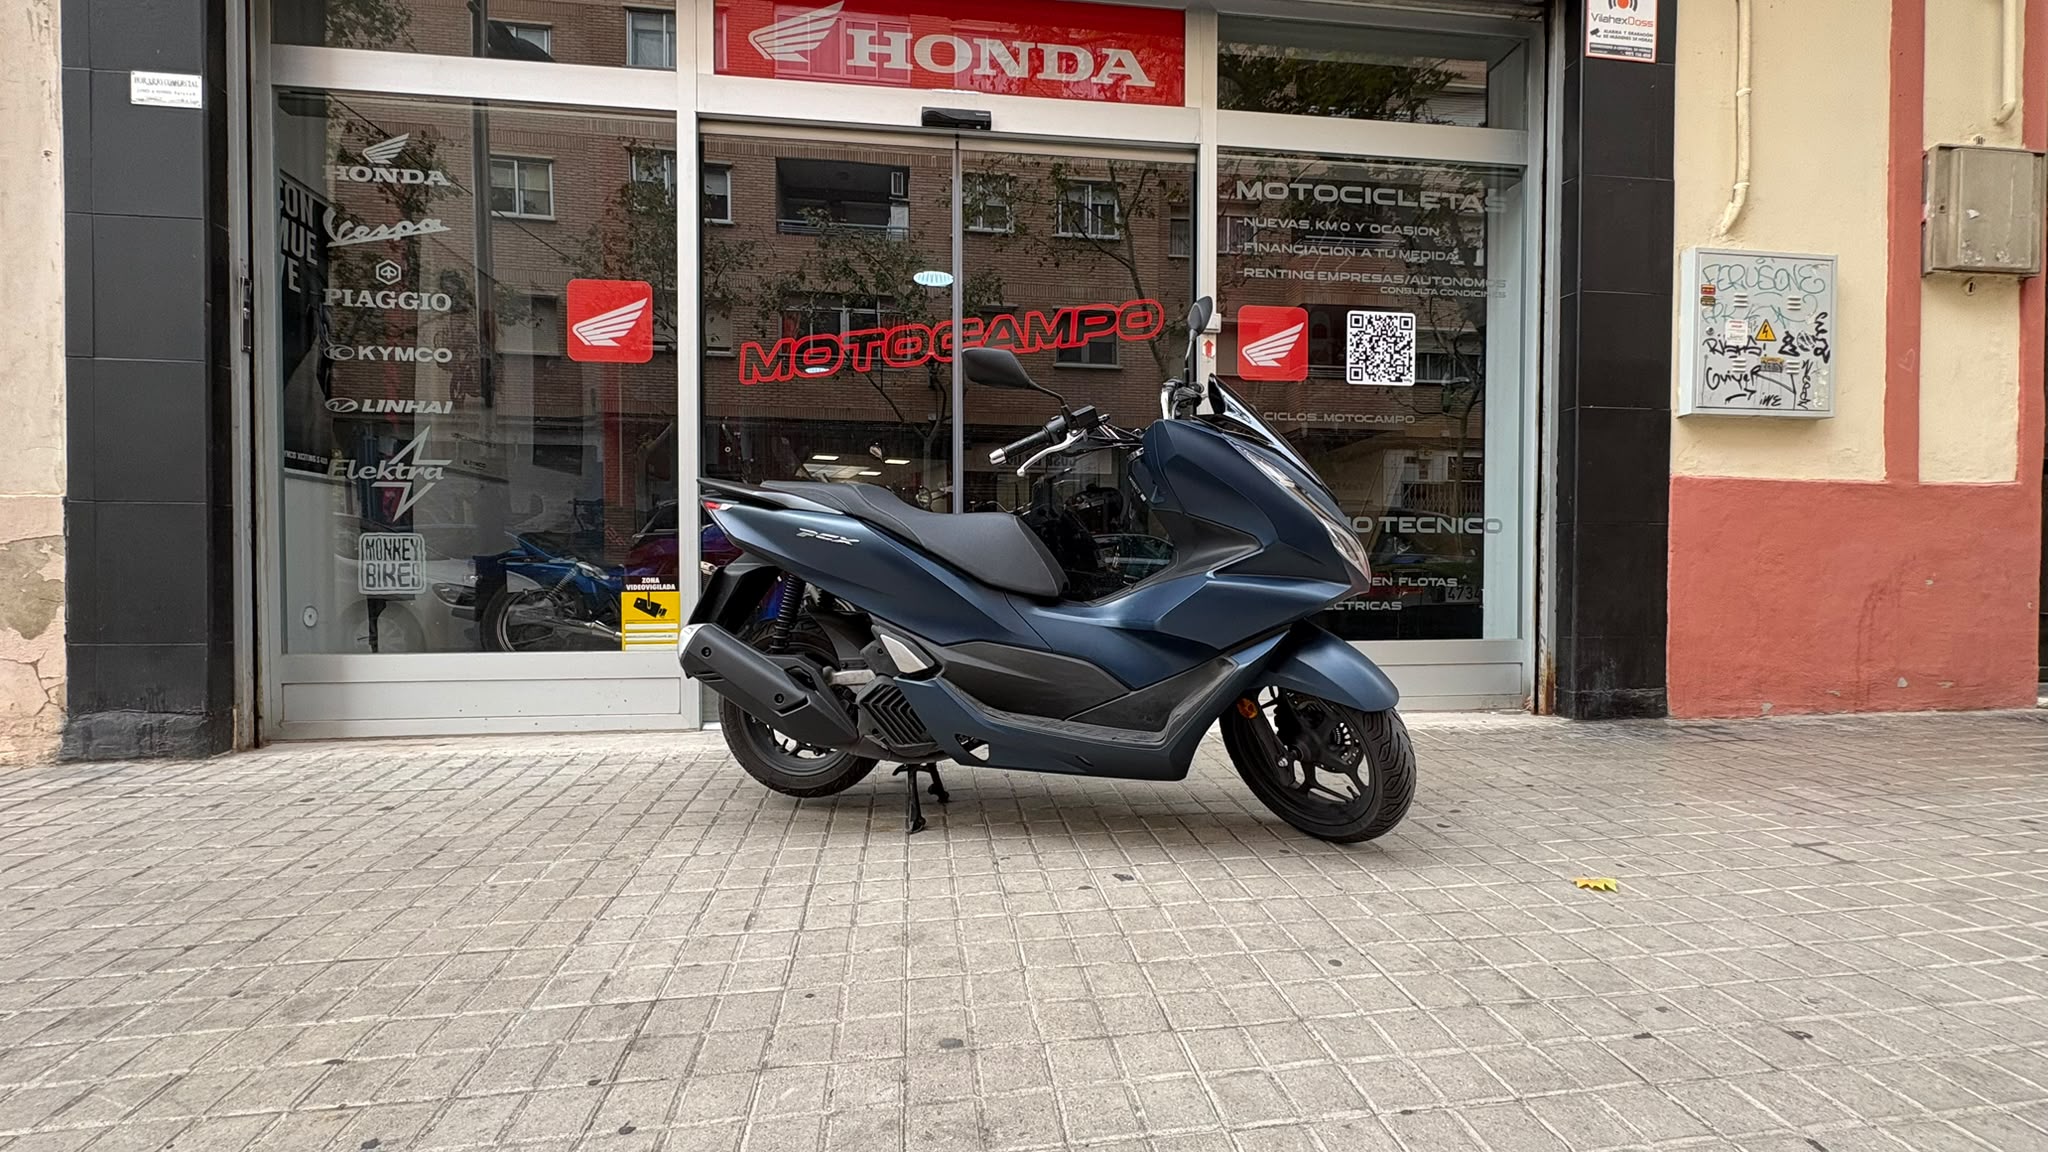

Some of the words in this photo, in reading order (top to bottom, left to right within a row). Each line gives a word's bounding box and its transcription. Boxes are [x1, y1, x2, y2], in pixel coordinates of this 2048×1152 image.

[846, 28, 1156, 87] HONDA
[322, 164, 451, 186] HONDA
[1236, 180, 1507, 214] MOTOCICLETAS
[323, 206, 451, 248] Vespa
[1354, 223, 1365, 232] Y
[1369, 224, 1440, 236] OCASION
[1360, 248, 1371, 257] A
[1374, 249, 1395, 259] TU
[1399, 249, 1457, 261] MEDIDA
[322, 288, 452, 312] PIAGGIO
[1380, 286, 1438, 296] CONSULTA
[739, 299, 1165, 385] MOTOCAMPO
[358, 345, 453, 363] KYMCO
[361, 399, 454, 415] LINHAI
[326, 459, 445, 481] Elektra
[1378, 516, 1503, 534] TECNICO
[365, 538, 420, 562] MONKEY
[365, 562, 421, 588] BIKES
[1398, 577, 1458, 587] FLOTAS
